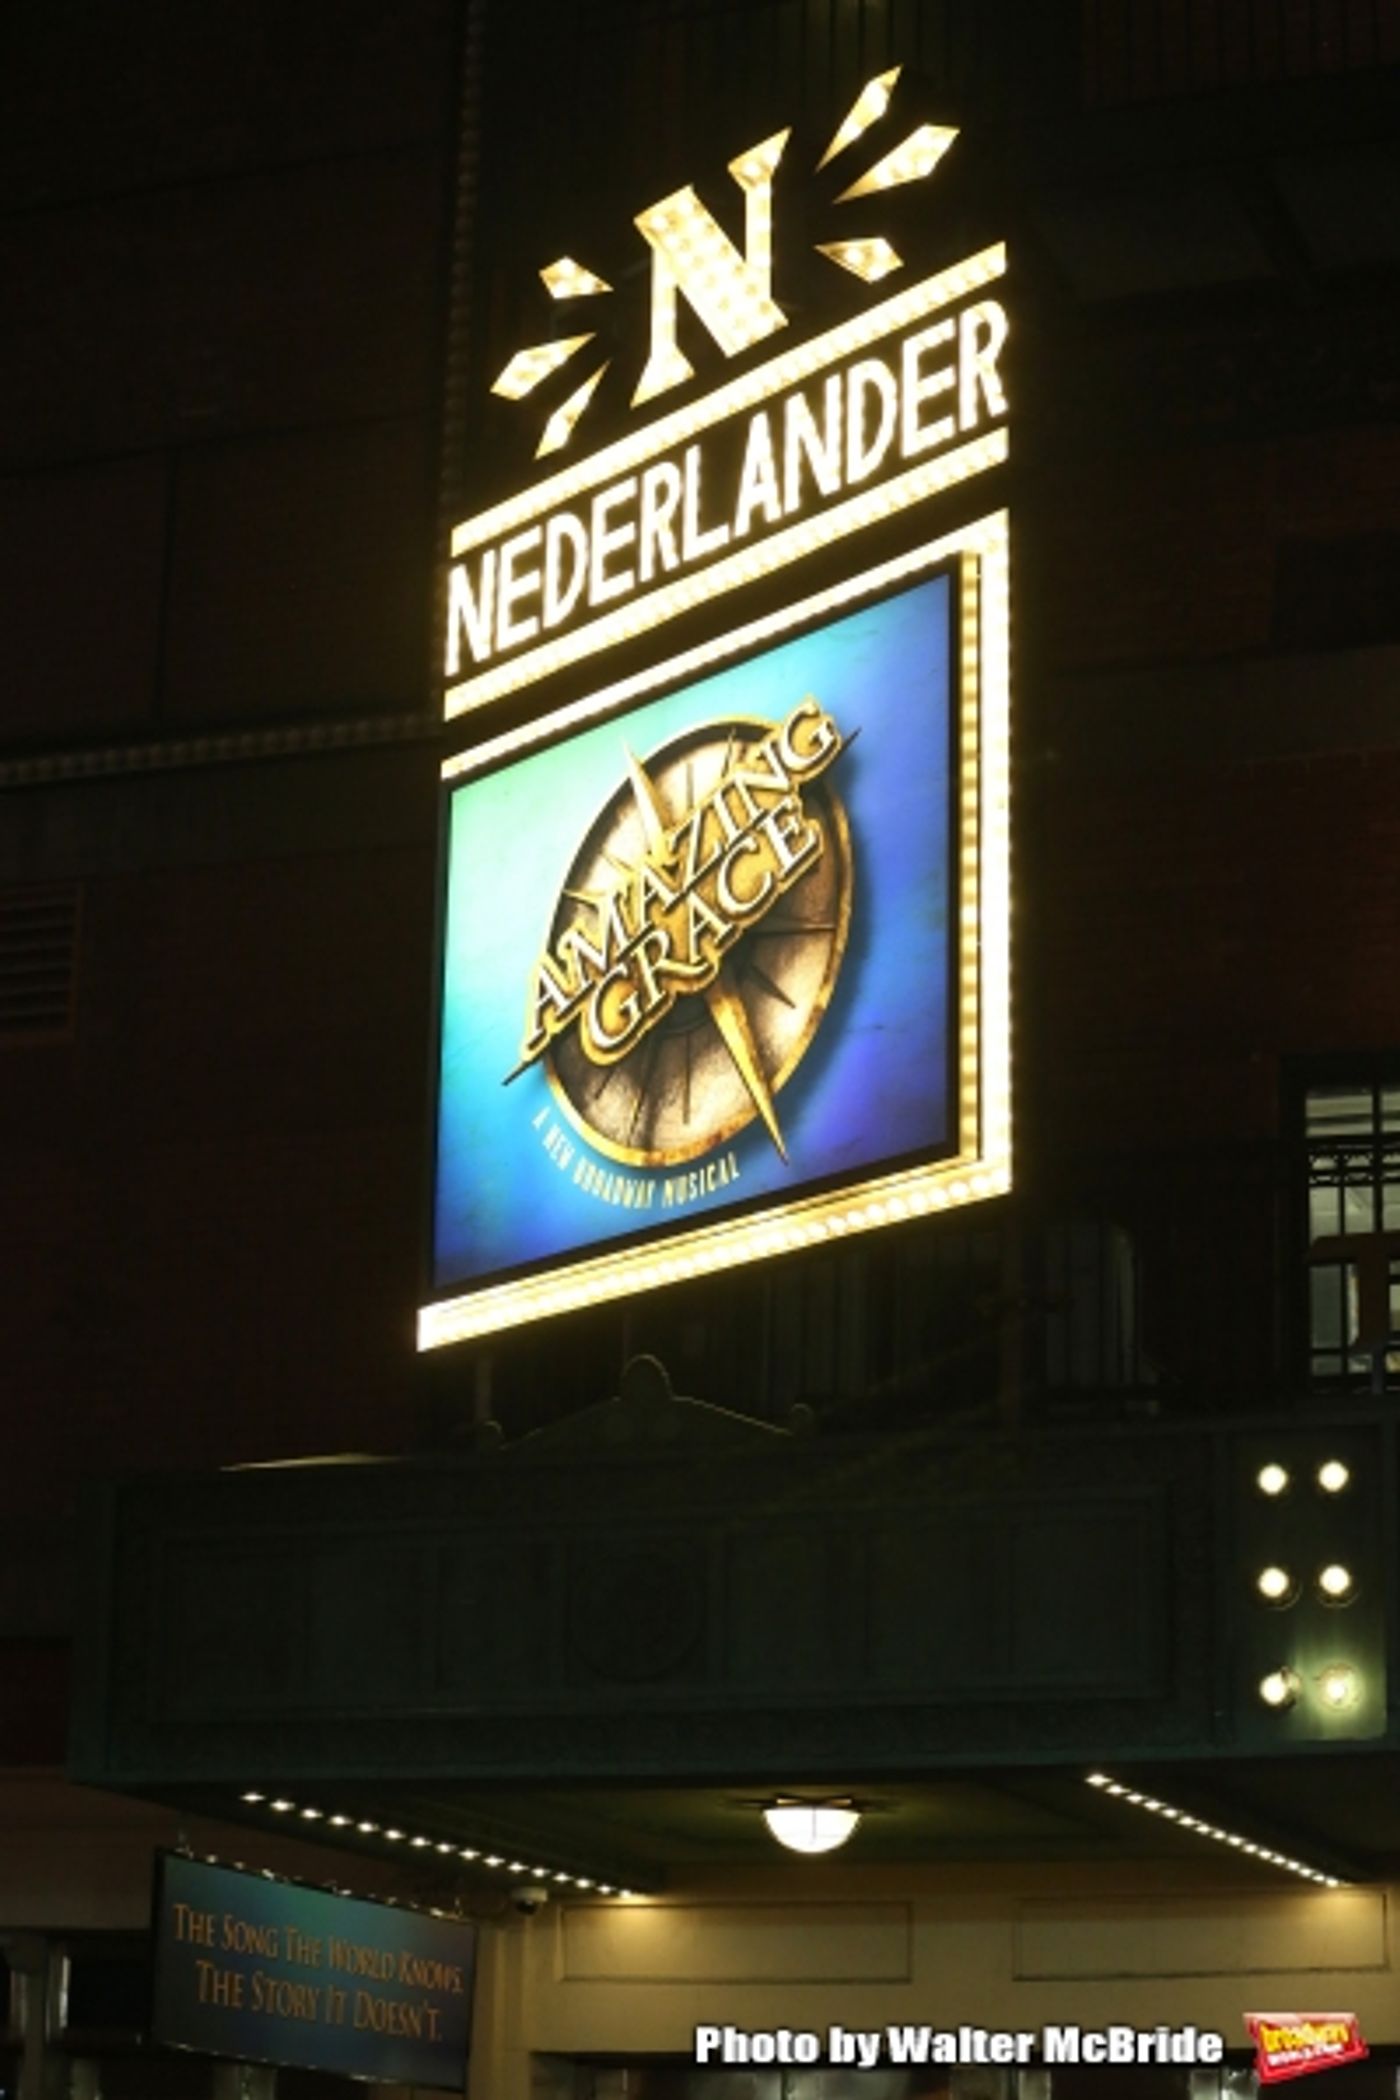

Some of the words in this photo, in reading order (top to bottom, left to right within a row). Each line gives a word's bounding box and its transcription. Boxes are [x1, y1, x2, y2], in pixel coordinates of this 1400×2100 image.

[630, 126, 792, 410] N
[444, 299, 1009, 676] NEDERLANDER
[523, 697, 842, 1056] AMAZING
[584, 794, 819, 1060] GRACE
[531, 1105, 550, 1131] A
[541, 1122, 575, 1172] NEW
[572, 1156, 657, 1210] BROADWAY
[661, 1150, 741, 1209] MUSICAL
